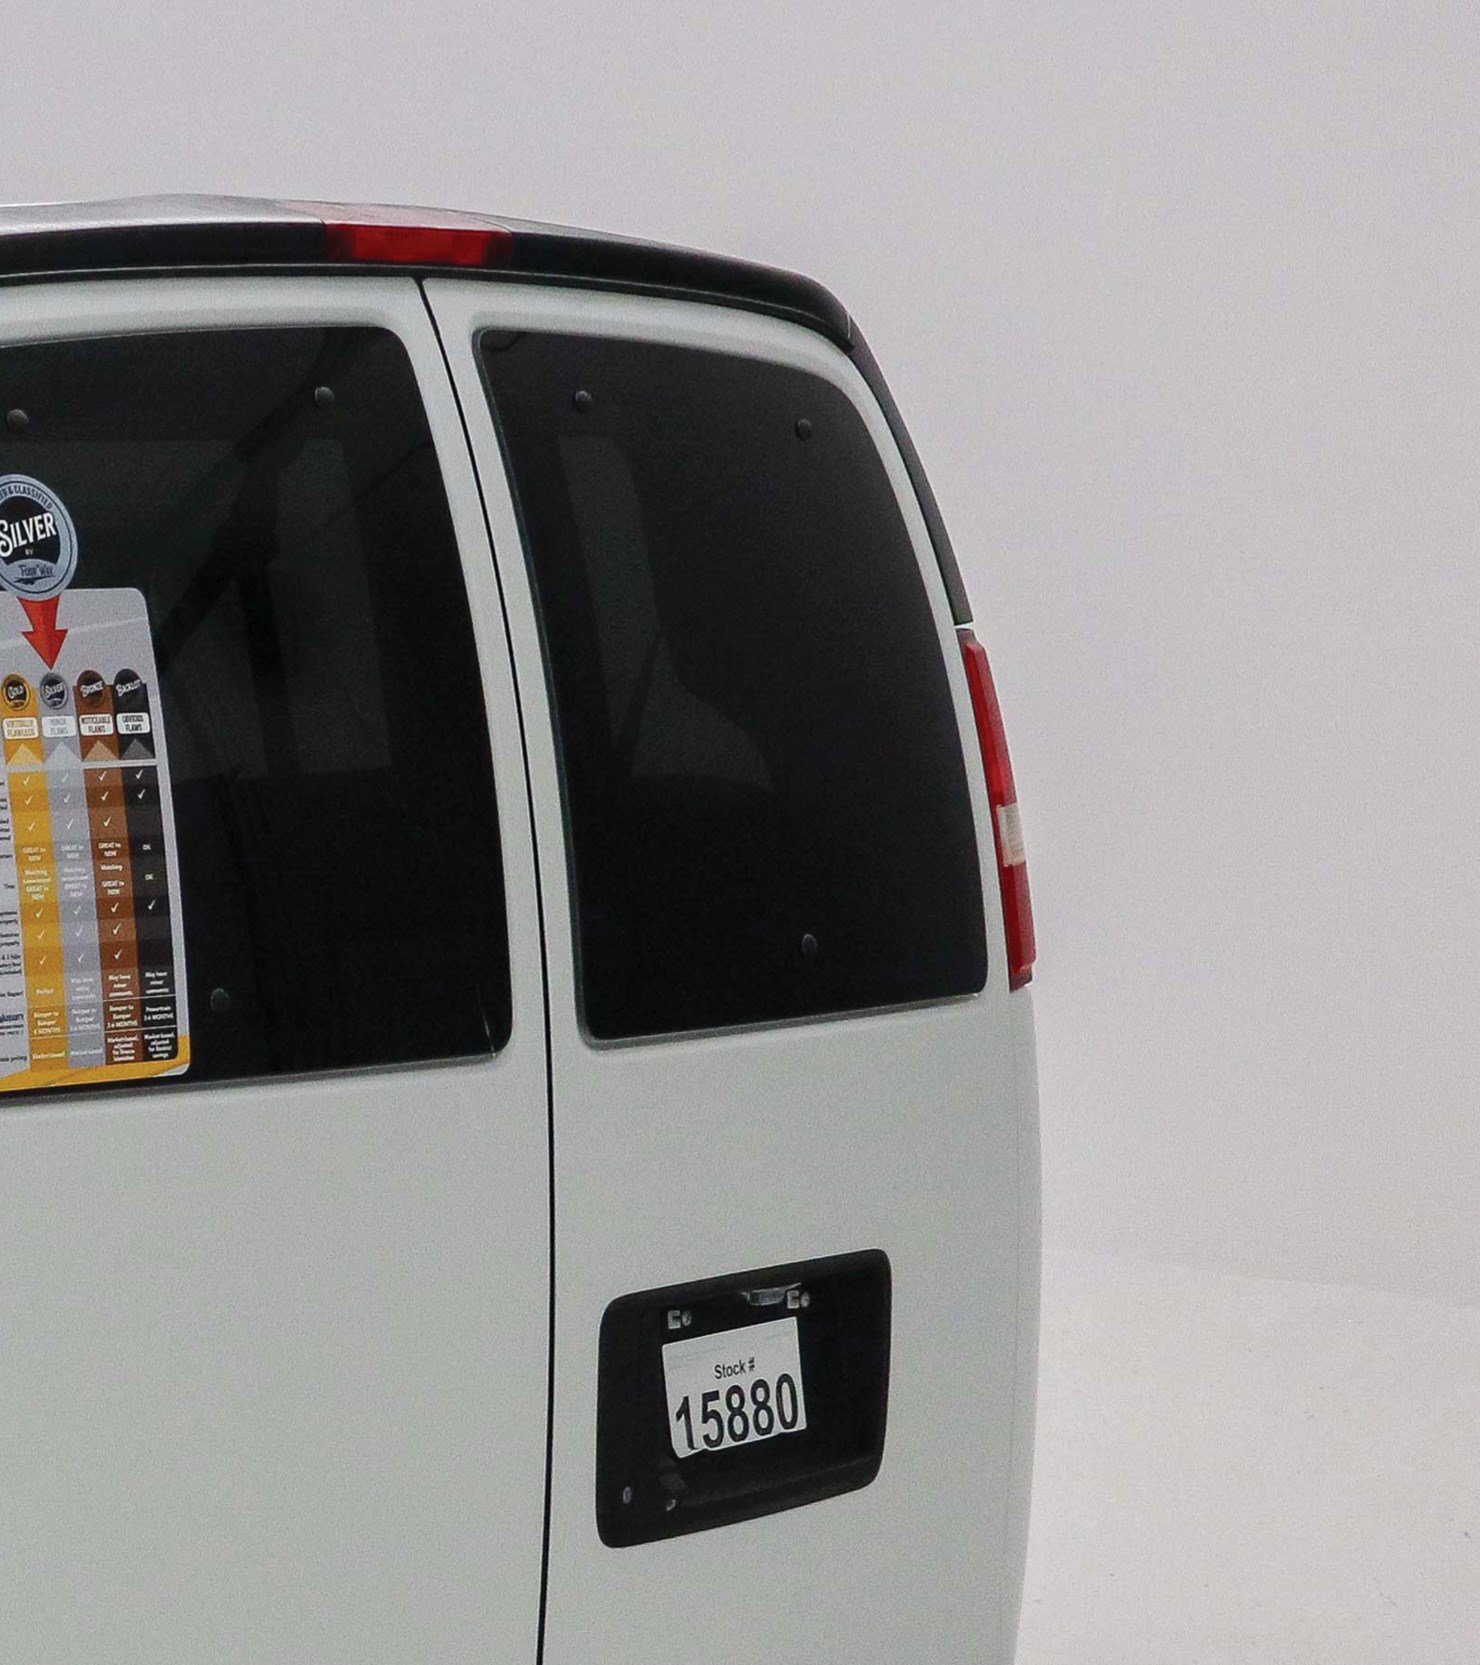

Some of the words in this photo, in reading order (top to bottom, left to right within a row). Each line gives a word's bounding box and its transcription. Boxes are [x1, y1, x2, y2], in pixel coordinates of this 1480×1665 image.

[7, 685, 24, 699] GOLD
[44, 682, 64, 699] SILVER
[714, 1359, 747, 1380] Stock
[747, 1356, 756, 1371] #
[675, 1373, 799, 1450] 15880
